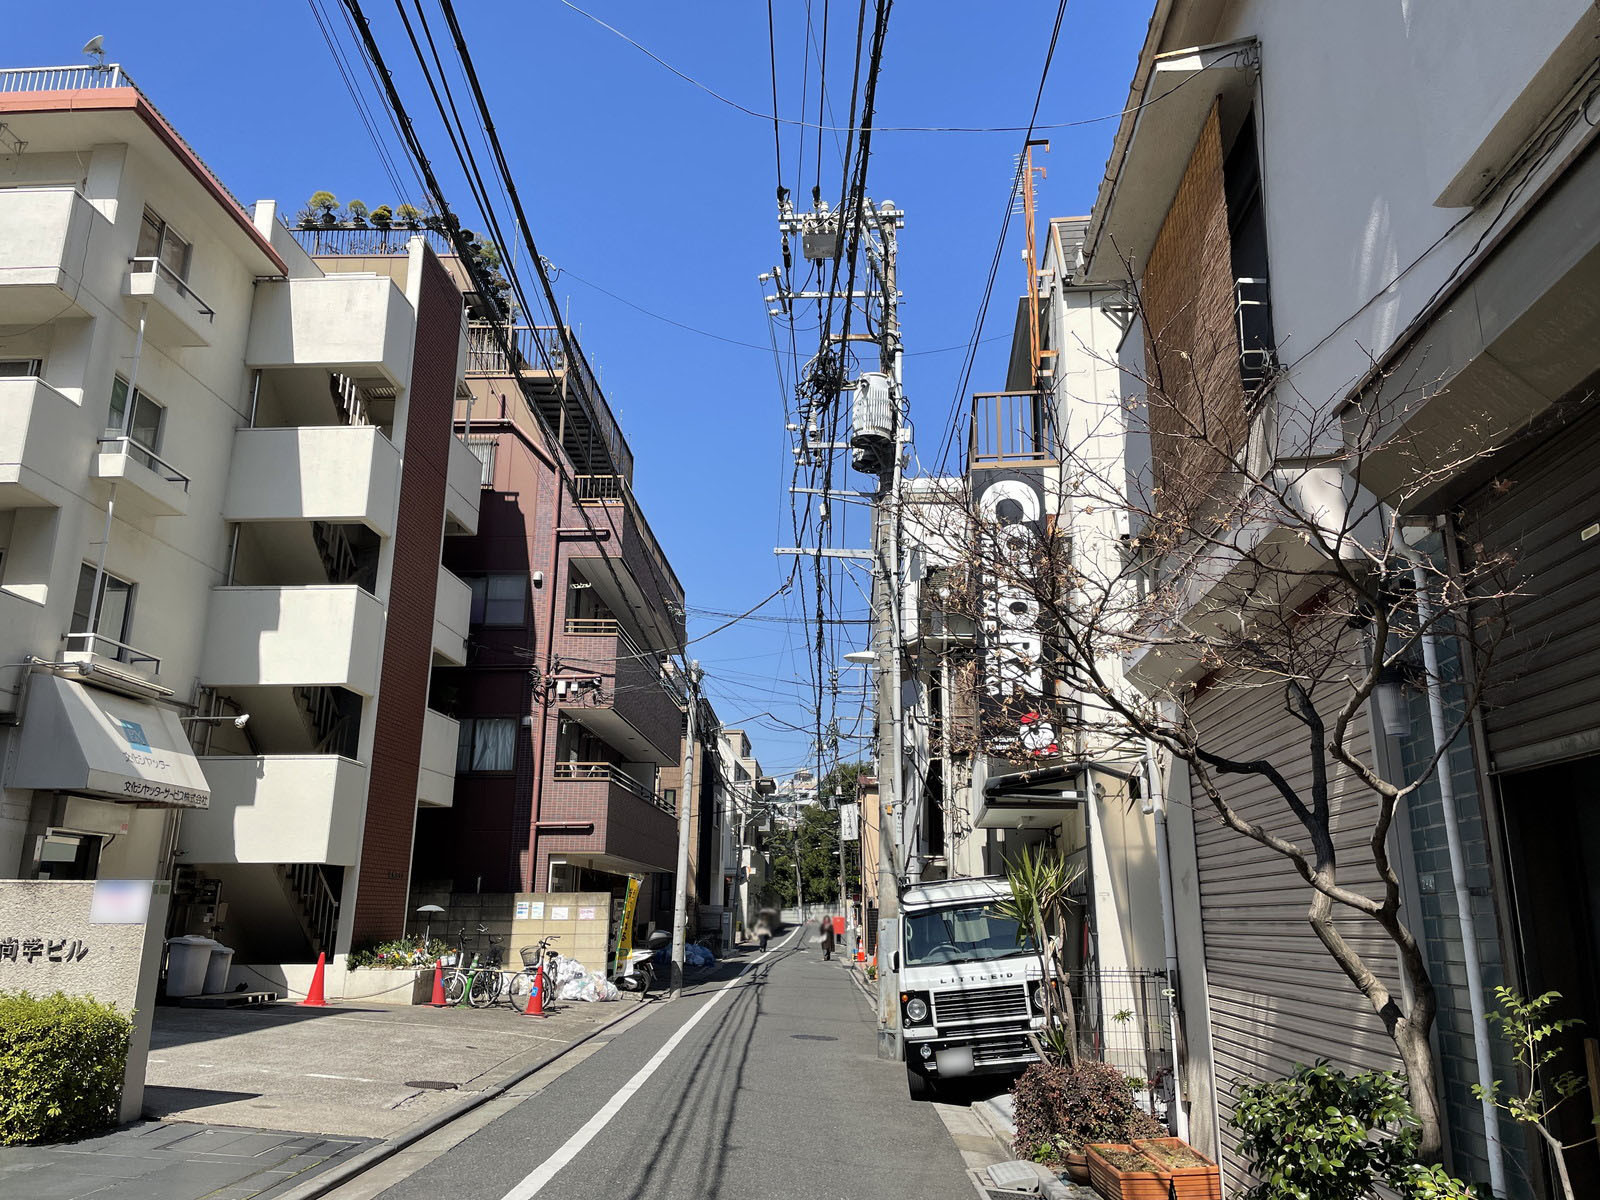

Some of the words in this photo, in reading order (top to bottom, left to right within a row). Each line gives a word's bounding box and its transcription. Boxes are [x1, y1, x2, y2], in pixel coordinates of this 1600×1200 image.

[124, 781, 208, 805] 文化シャッターサービス株式会社
